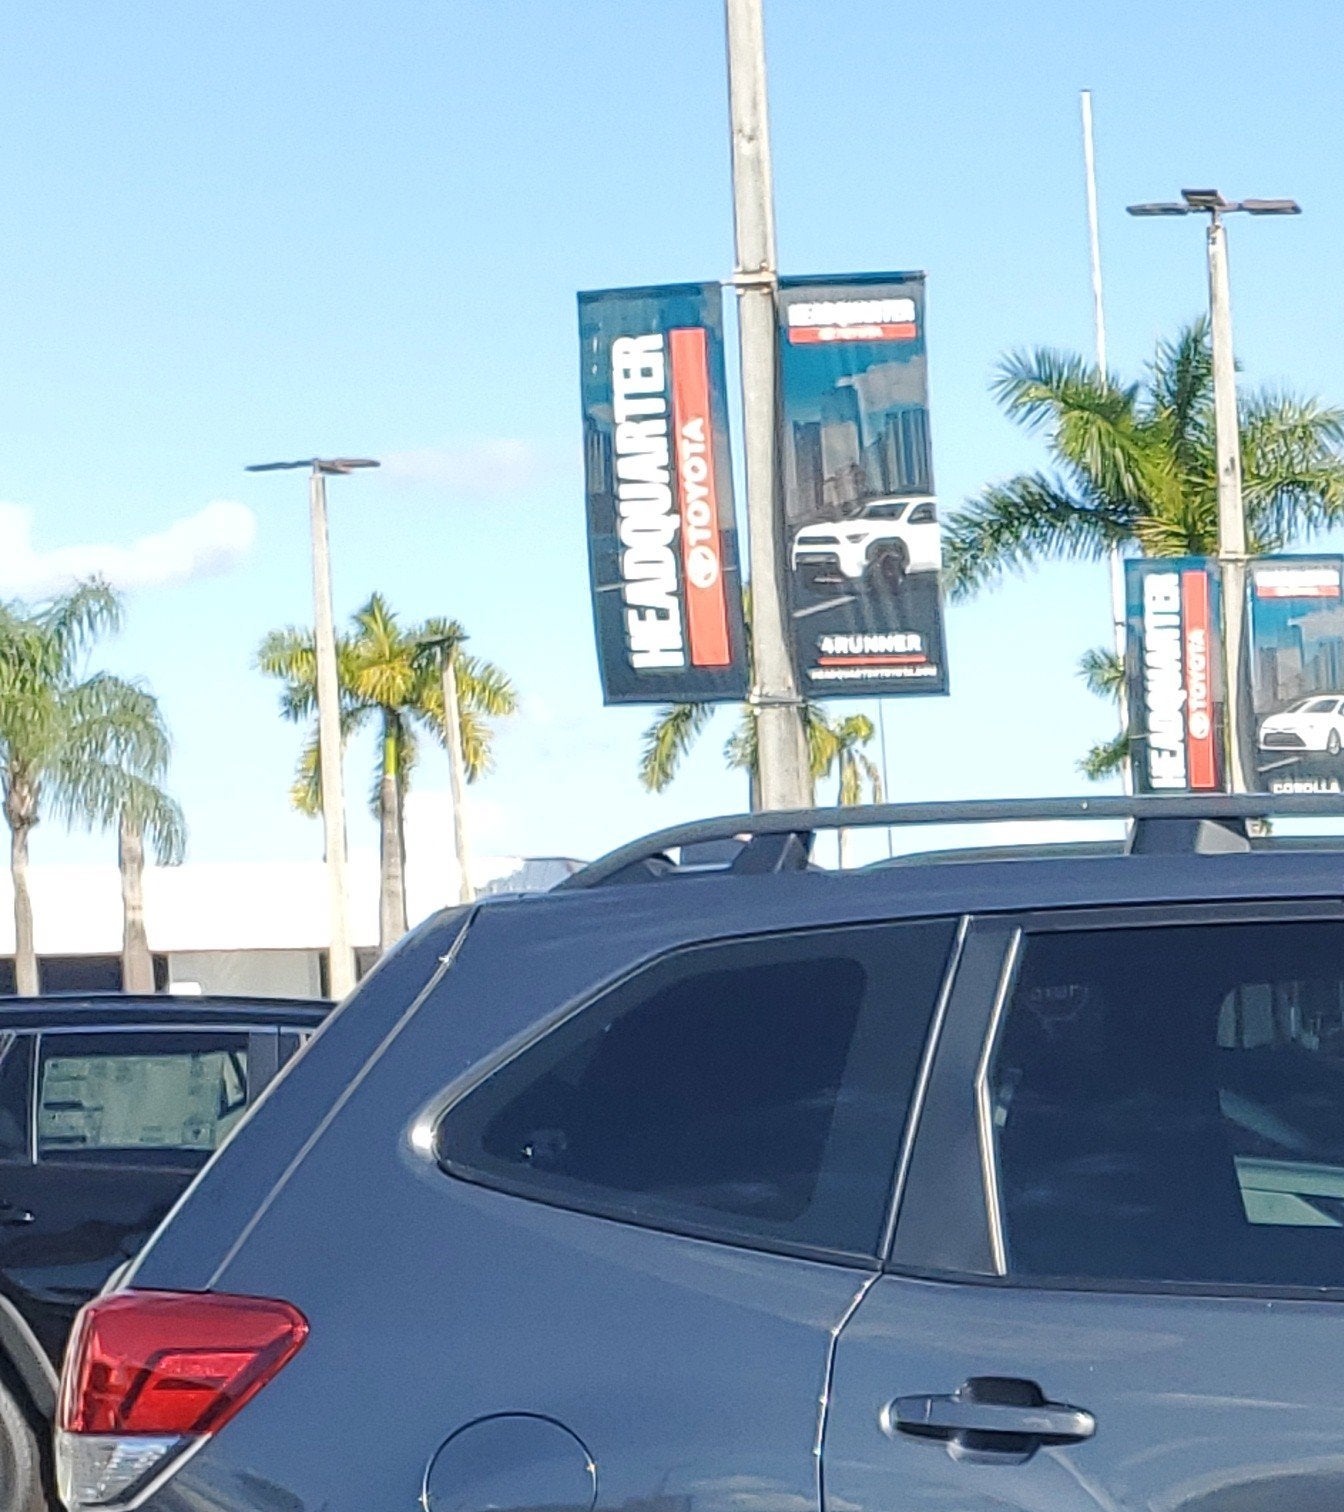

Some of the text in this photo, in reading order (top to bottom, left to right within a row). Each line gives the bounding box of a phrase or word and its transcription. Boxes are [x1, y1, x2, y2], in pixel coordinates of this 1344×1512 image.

[611, 332, 686, 669] HEADQUARTER
[682, 417, 713, 547] TOYOTA
[820, 633, 922, 654] 4RUNNER
